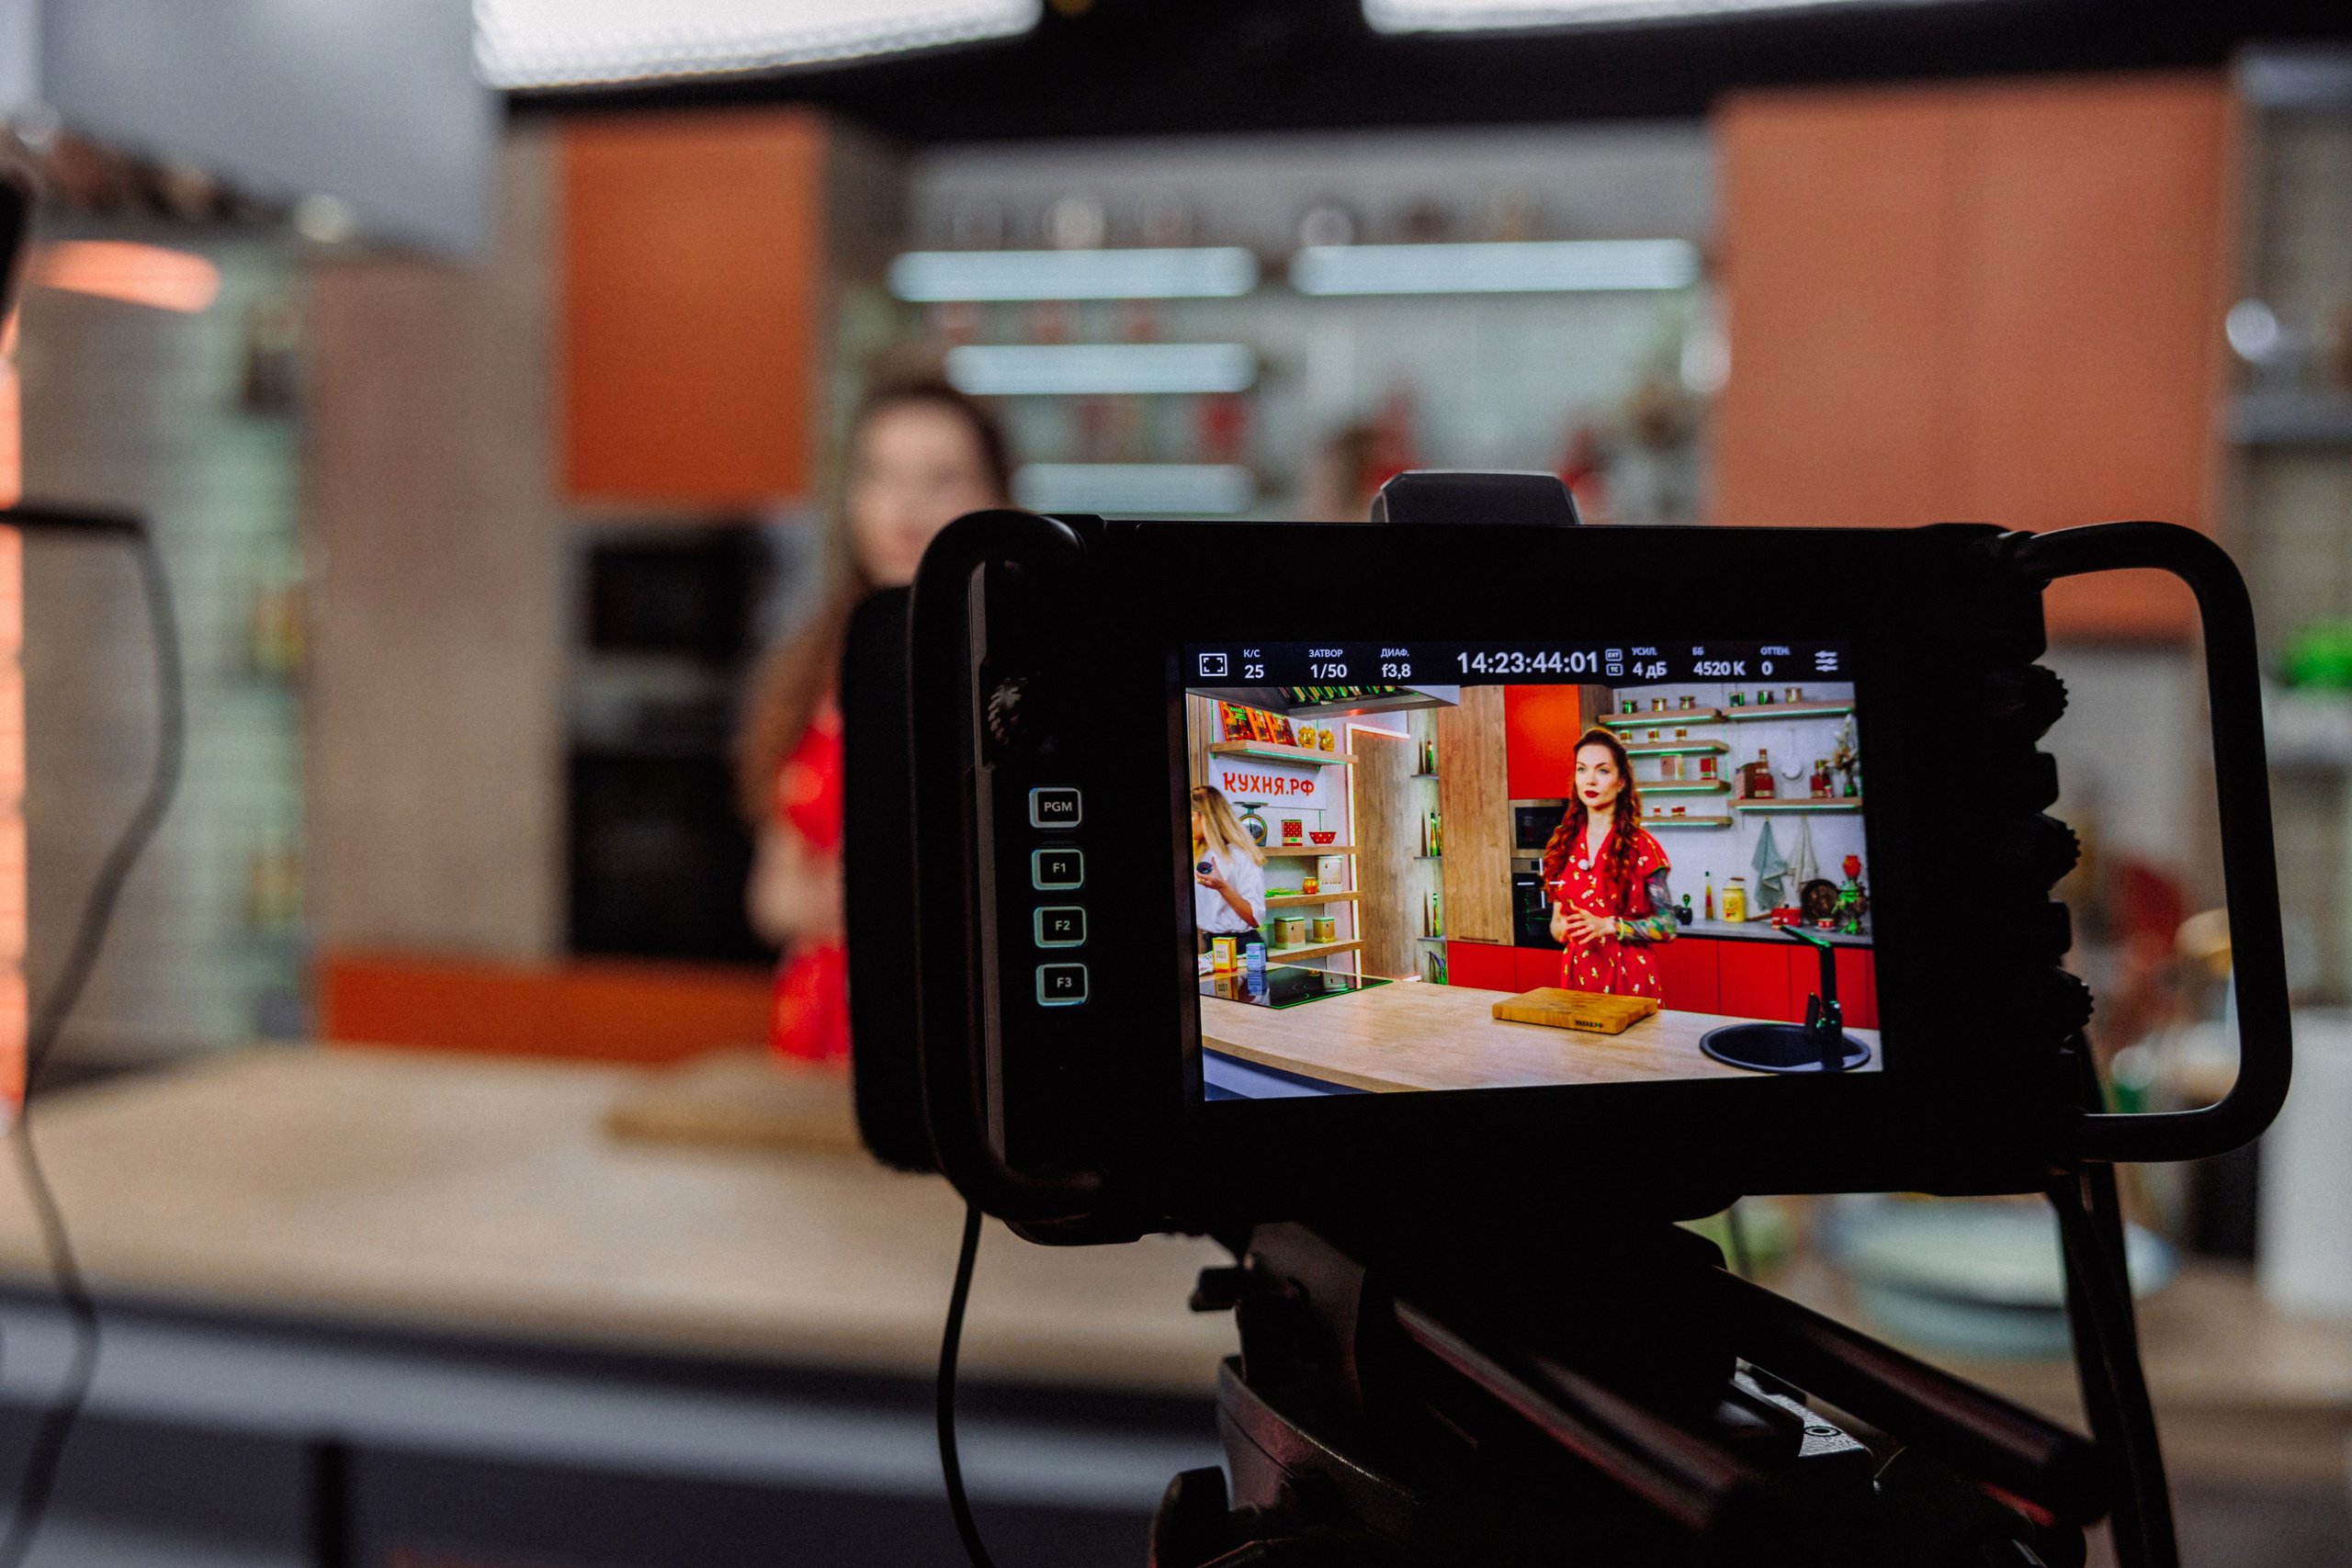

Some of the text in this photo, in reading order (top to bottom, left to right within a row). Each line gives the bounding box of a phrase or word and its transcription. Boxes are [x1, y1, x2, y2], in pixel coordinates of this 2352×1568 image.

[1243, 649, 1261, 658] К/С
[1308, 649, 1343, 658] ЗАТВОР
[1380, 649, 1409, 658] ДИАФ.
[1457, 651, 1598, 673] 14:23:44:01
[1693, 661, 1731, 677] 4520
[1762, 661, 1773, 676] 0
[1244, 665, 1264, 679] 25
[1310, 663, 1347, 679] 1/50
[1382, 663, 1411, 679] f3,8
[1633, 661, 1668, 679] 4 дБ
[1223, 772, 1315, 796] КУХНЯ.РФ
[1044, 802, 1073, 812] PGM
[1053, 863, 1067, 874] F1
[1056, 919, 1070, 931] F2
[1057, 977, 1072, 987] F3
